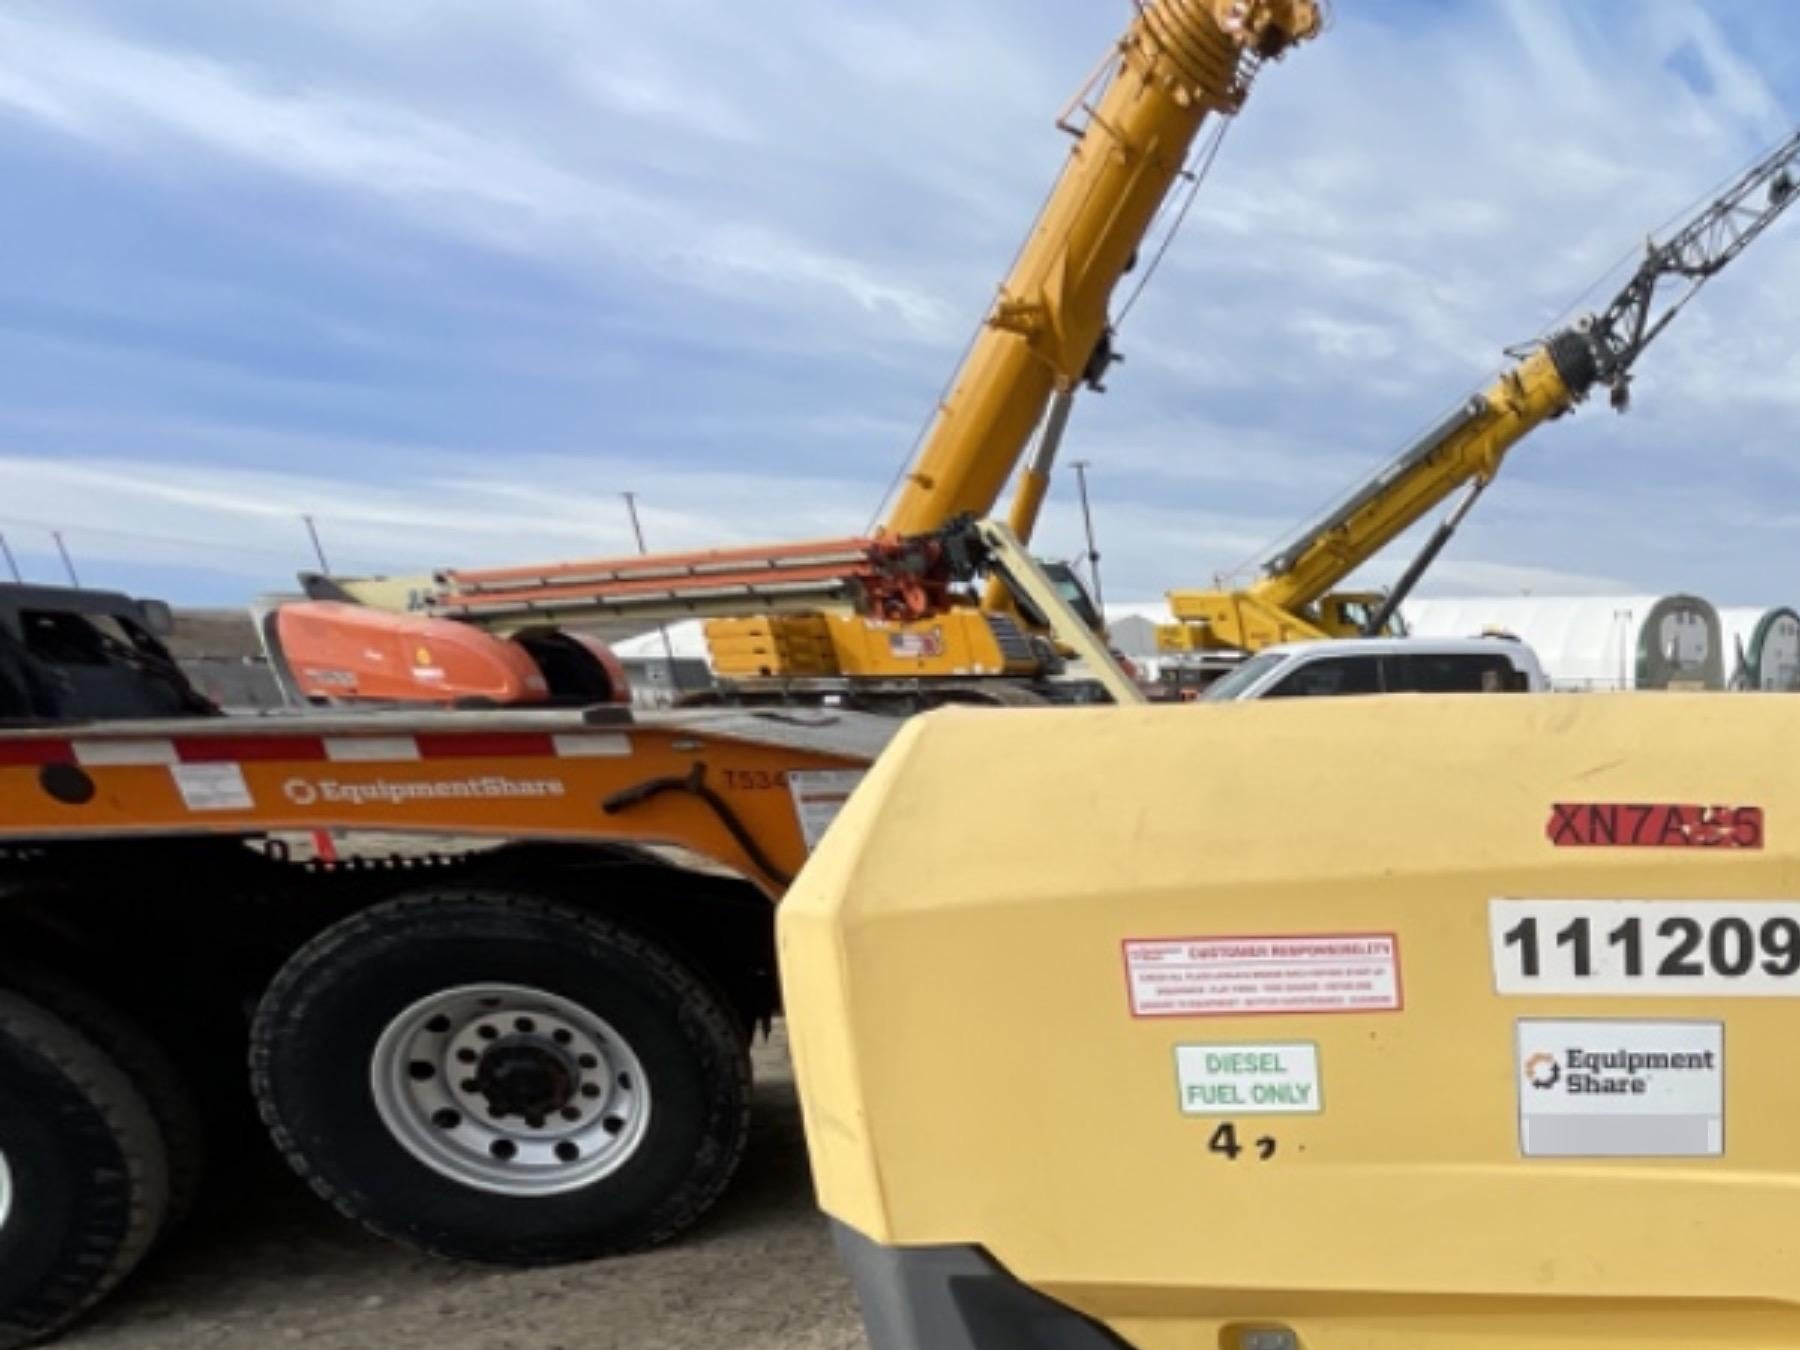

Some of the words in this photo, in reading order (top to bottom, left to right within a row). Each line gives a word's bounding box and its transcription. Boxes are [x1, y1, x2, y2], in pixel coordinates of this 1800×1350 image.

[317, 776, 565, 804] EquipmentShare
[1205, 1053, 1288, 1074] DIESEL
[1565, 1048, 1714, 1074] Equipment
[1187, 1084, 1246, 1105] FUEL
[1252, 1082, 1312, 1105] ONLY
[1566, 1073, 1646, 1095] Share
